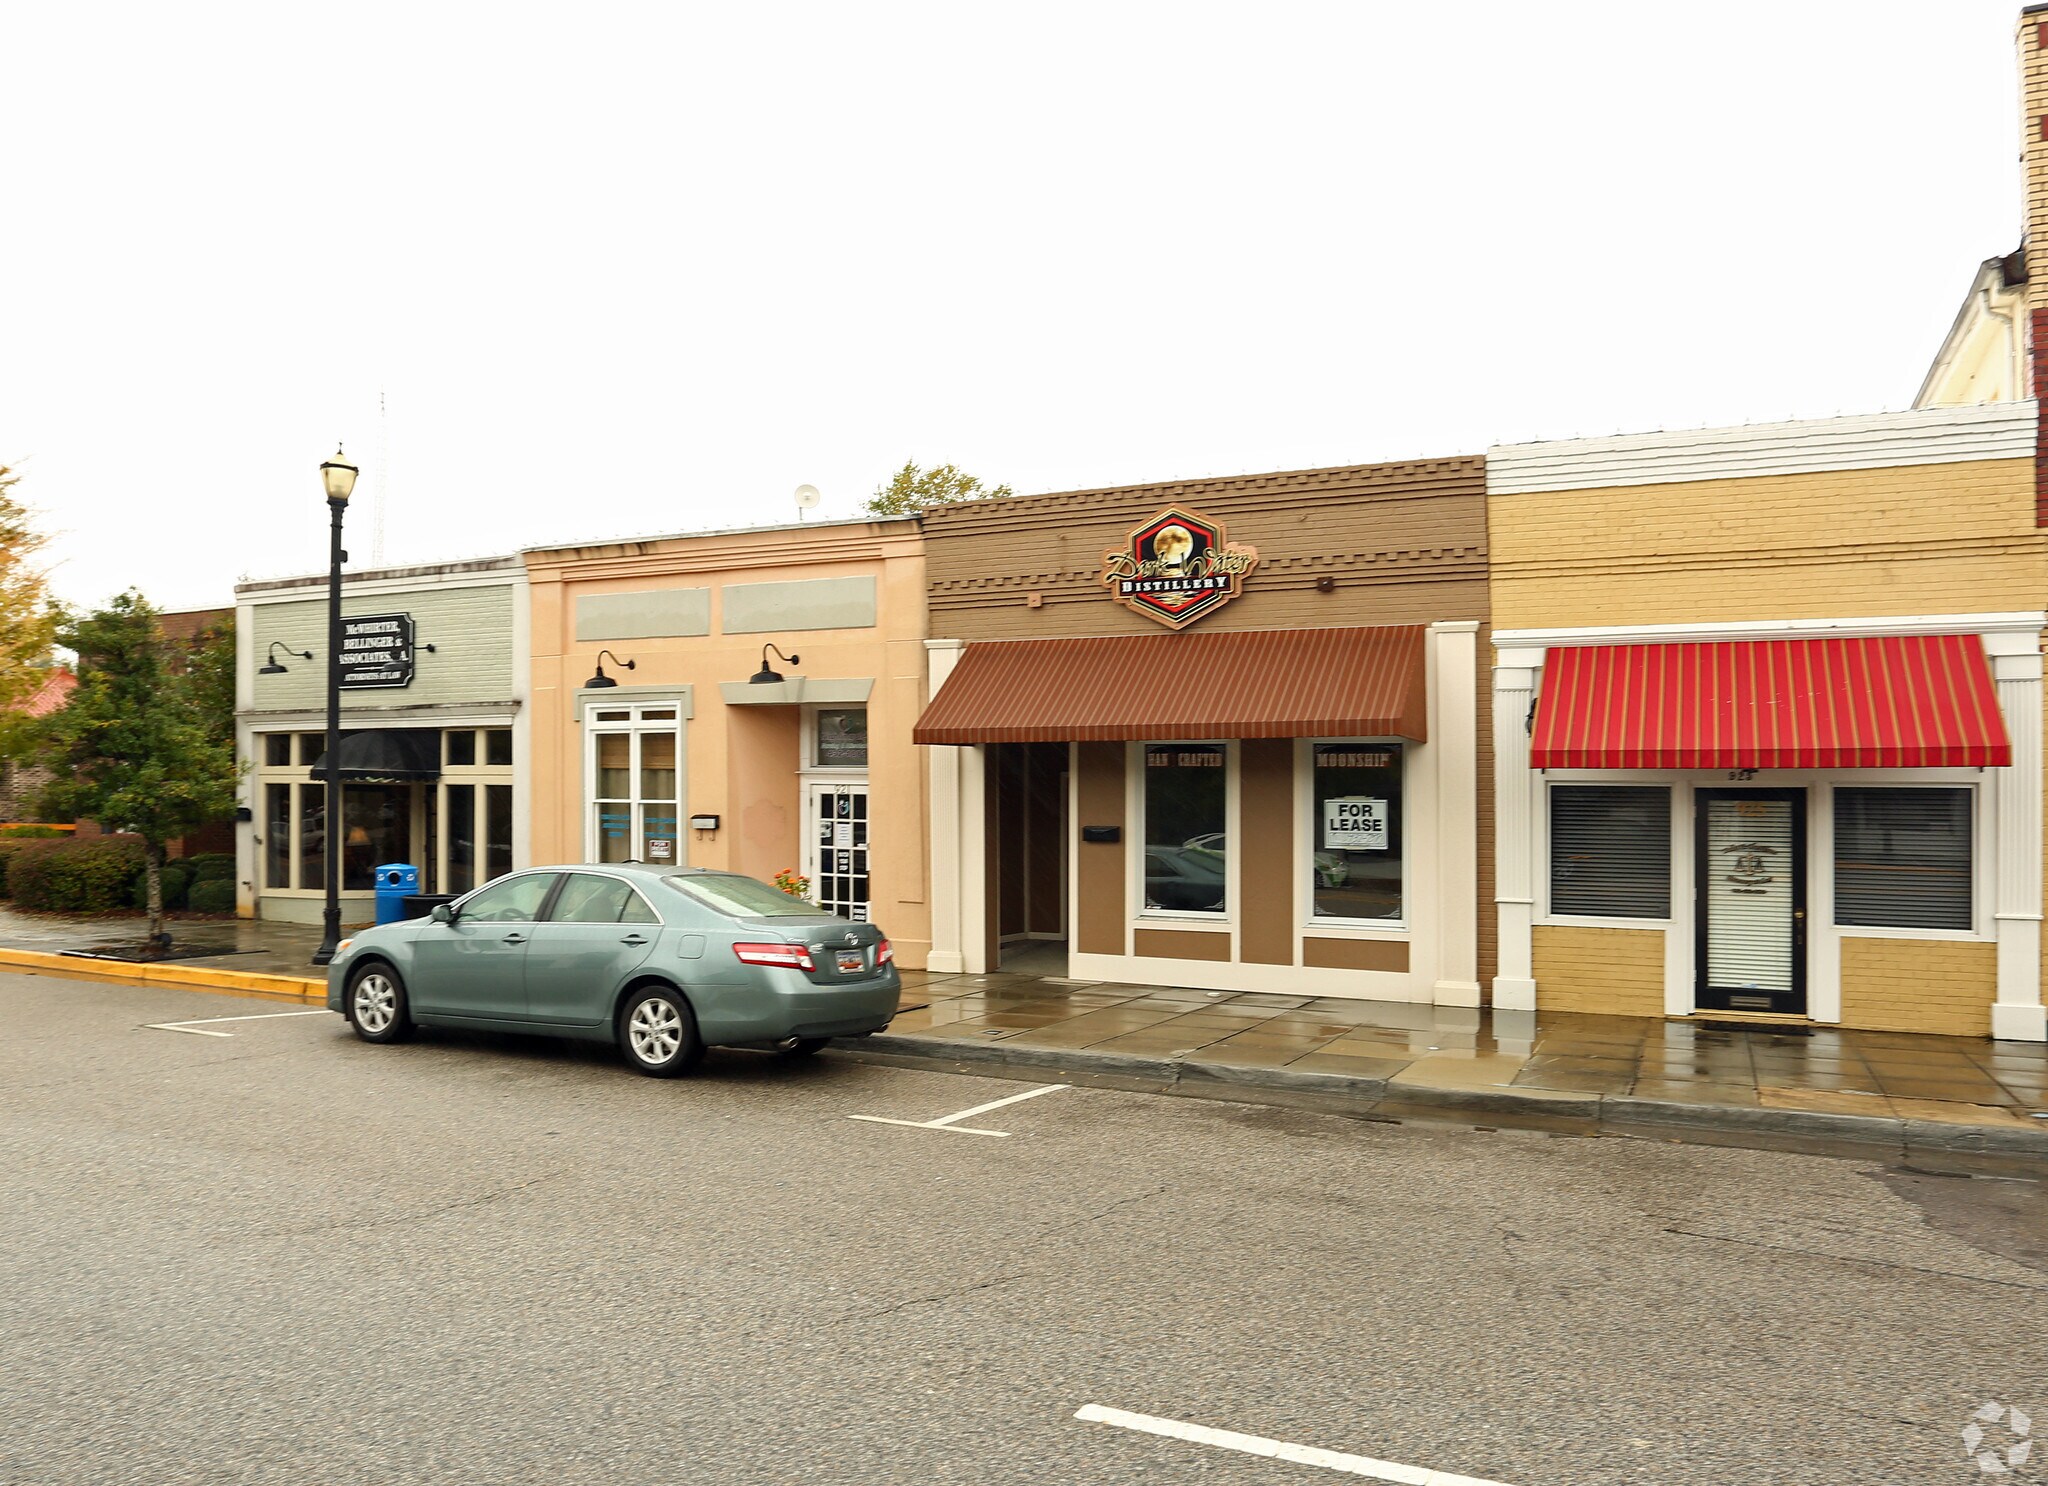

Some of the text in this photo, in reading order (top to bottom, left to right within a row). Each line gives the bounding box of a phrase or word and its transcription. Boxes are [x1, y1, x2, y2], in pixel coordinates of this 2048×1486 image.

[1104, 547, 1252, 583] Dark Water
[1121, 576, 1228, 593] DISTILLERY
[1177, 753, 1223, 767] CRAFTED
[1338, 804, 1373, 817] FOR
[1330, 819, 1382, 831] LEASE
